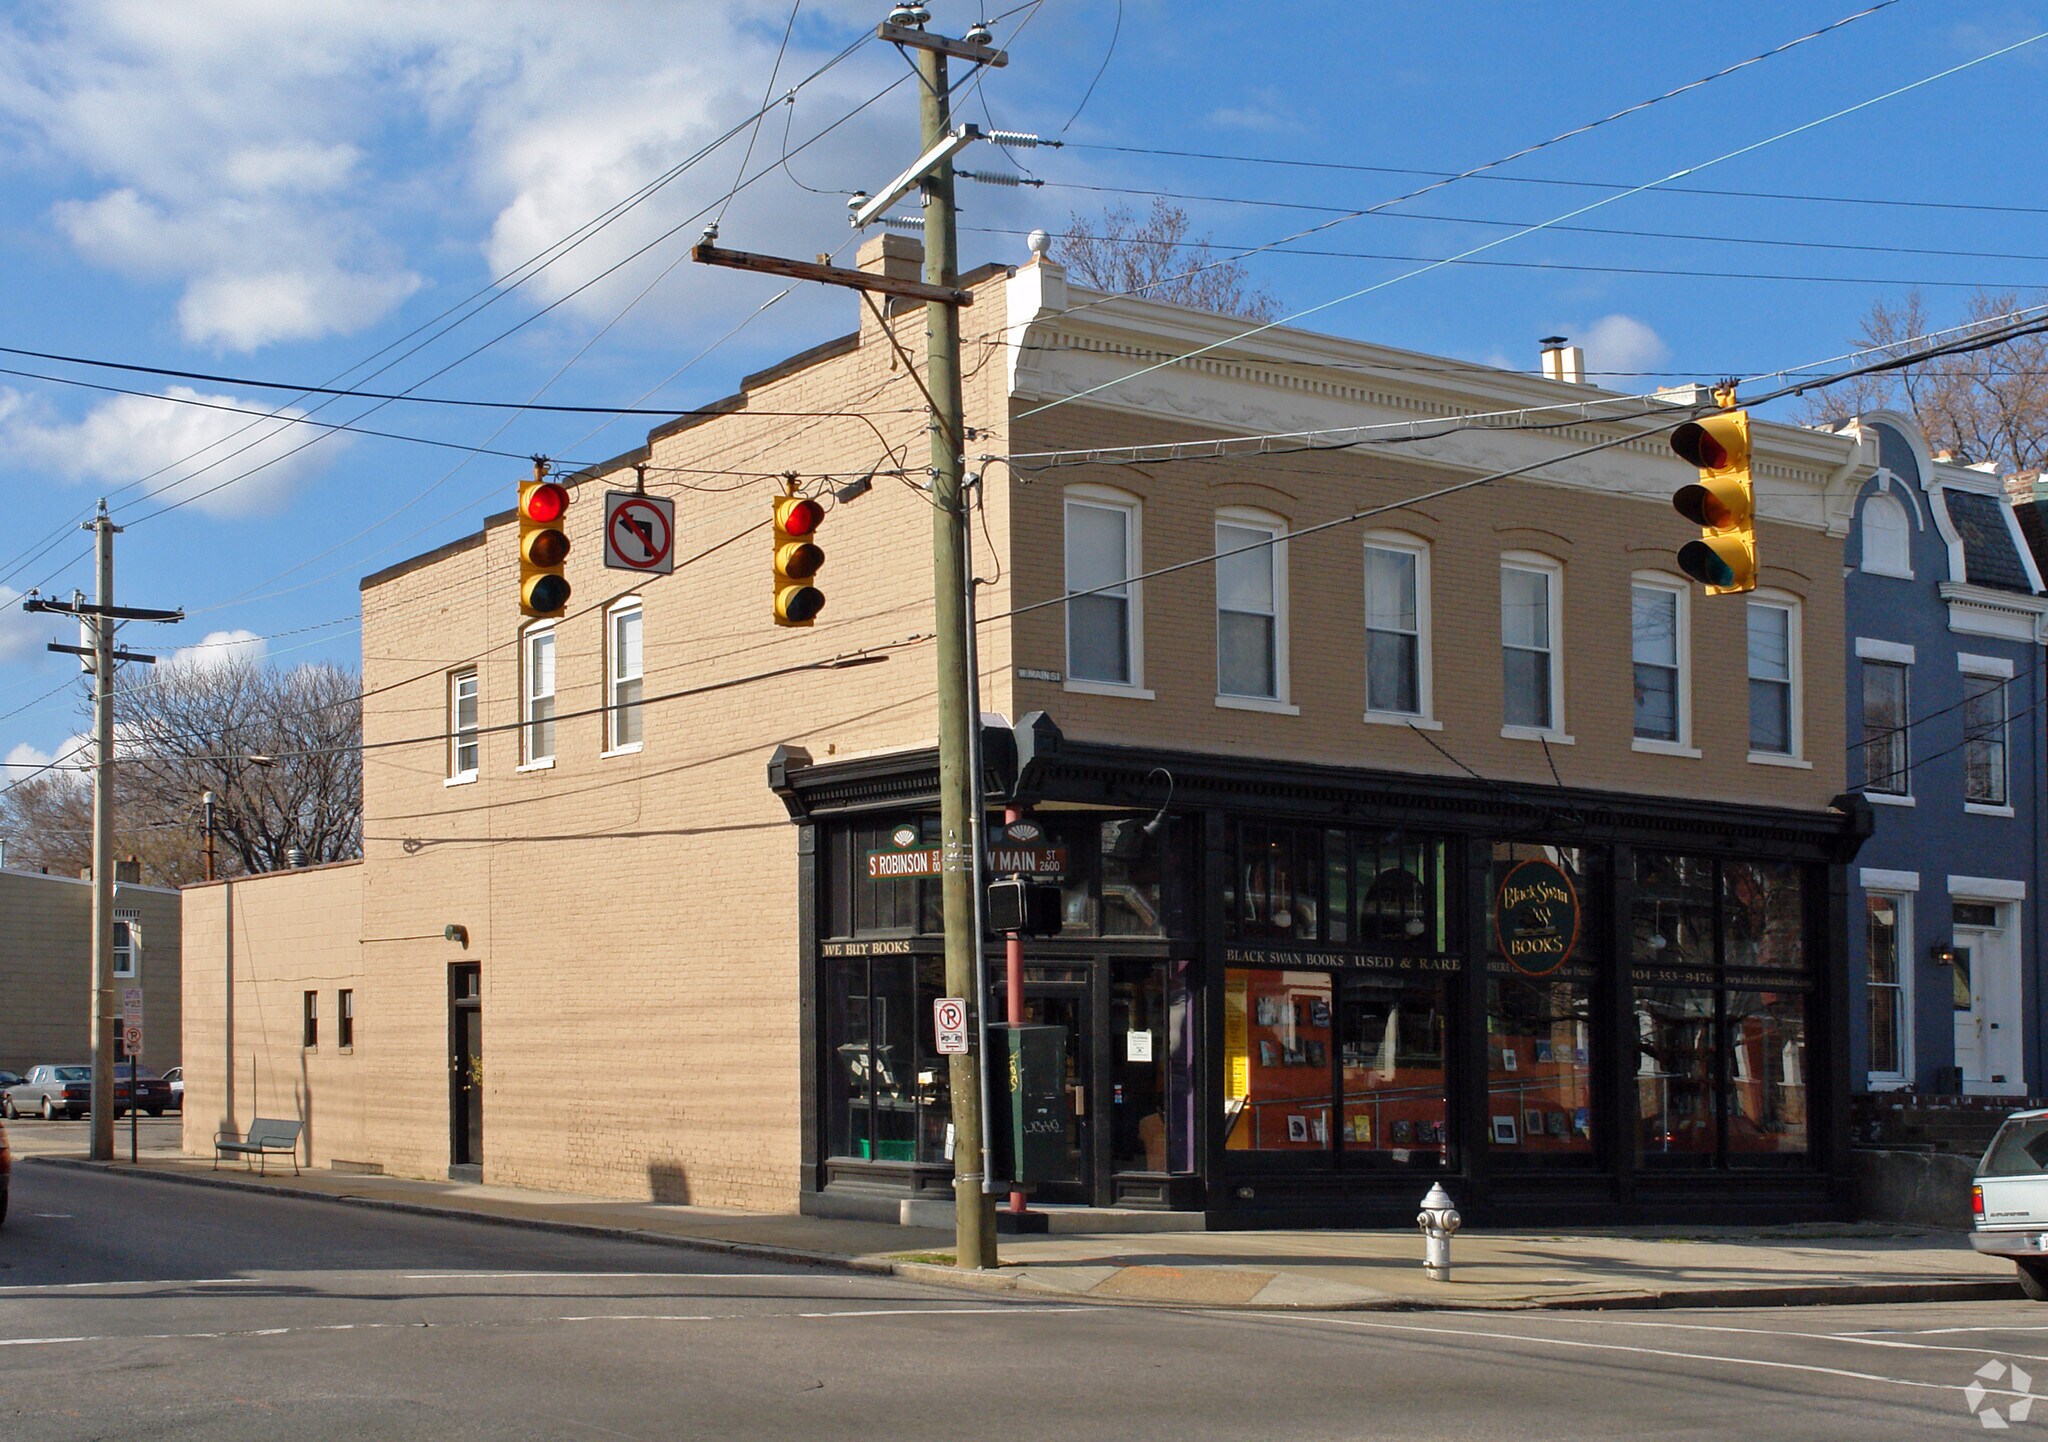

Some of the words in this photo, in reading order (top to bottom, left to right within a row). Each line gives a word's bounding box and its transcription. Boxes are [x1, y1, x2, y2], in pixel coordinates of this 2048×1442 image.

[869, 856, 877, 876] S
[879, 852, 928, 875] ROBINSON
[932, 850, 940, 861] ST
[999, 851, 1036, 871] MAIN
[1046, 849, 1056, 860] ST
[1040, 861, 1060, 872] 2600
[1504, 885, 1535, 909] Black
[1536, 881, 1568, 904] Swan
[825, 944, 842, 956] WE
[846, 943, 868, 955] BUY
[872, 941, 910, 953] BOOKS
[1511, 936, 1563, 955] BOOKS
[1227, 949, 1265, 963] BLACK
[1270, 951, 1302, 964] SWAN
[1306, 953, 1345, 966] BOOKS
[1355, 956, 1394, 968] USED
[1400, 957, 1411, 969] &
[1420, 958, 1461, 970] RARE
